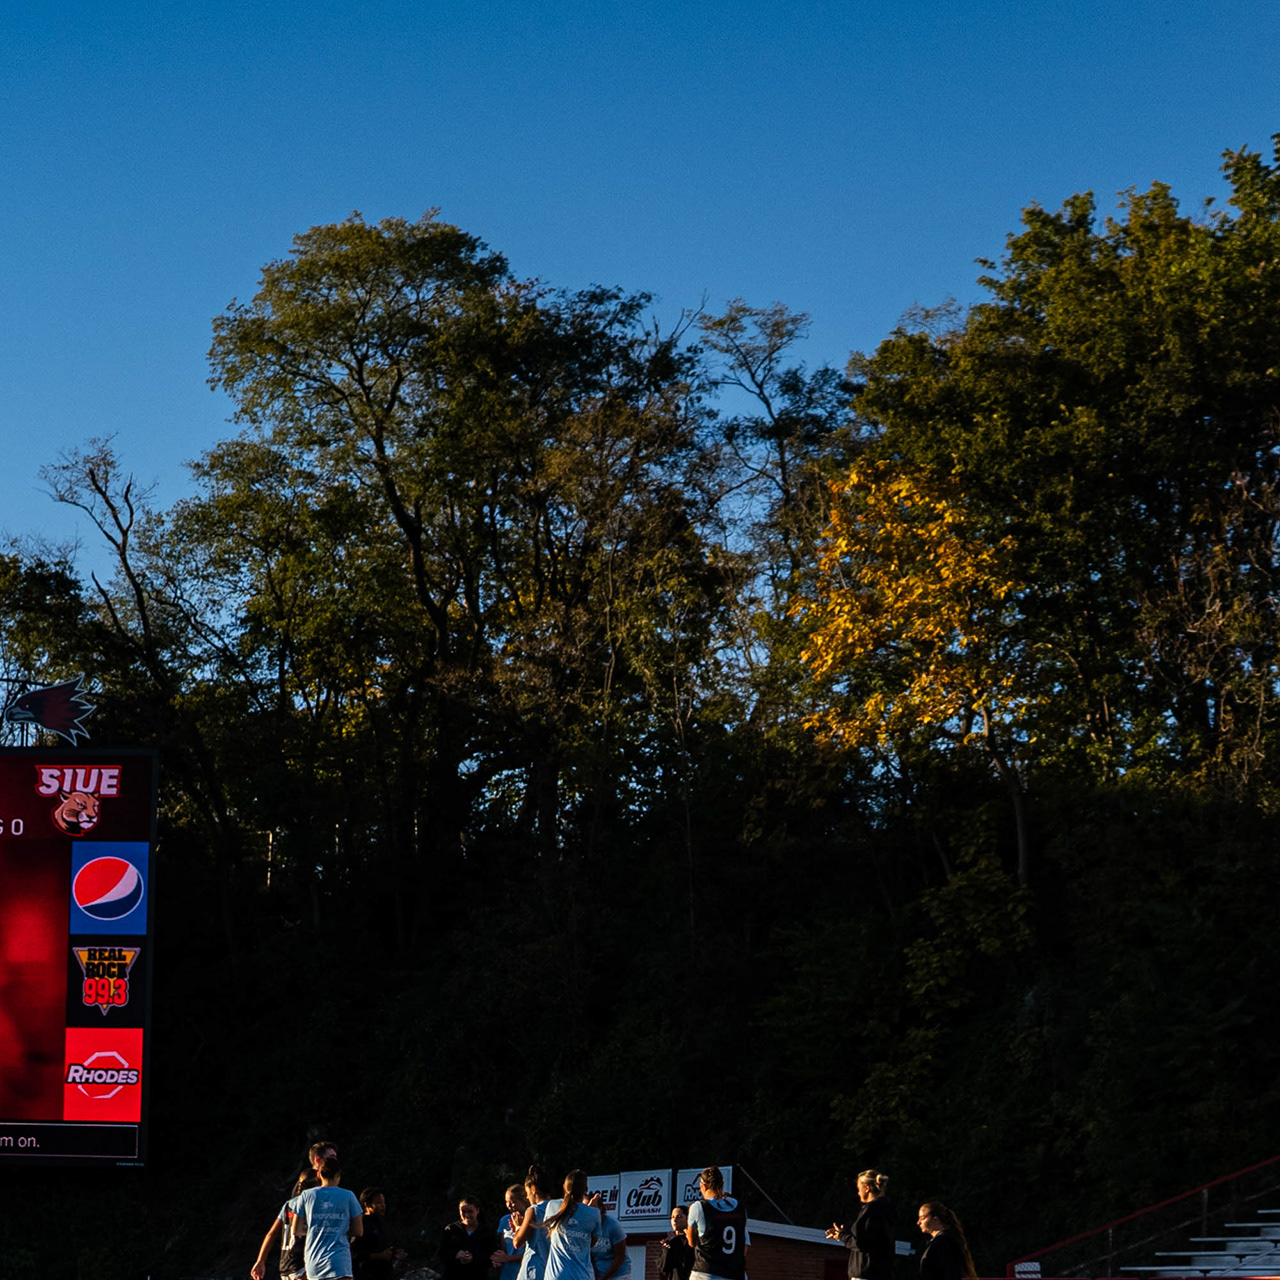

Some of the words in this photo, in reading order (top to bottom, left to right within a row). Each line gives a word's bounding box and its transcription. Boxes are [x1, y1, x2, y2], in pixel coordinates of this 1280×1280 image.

[37, 768, 120, 796] SIUE
[11, 819, 25, 836] 0
[88, 948, 127, 961] REAL
[85, 962, 128, 979] ROCK
[84, 978, 128, 1005] 99.3
[67, 1064, 139, 1084] RHODES
[17, 1136, 41, 1147] on.
[626, 1188, 663, 1207] Club
[722, 1225, 736, 1255] 9
